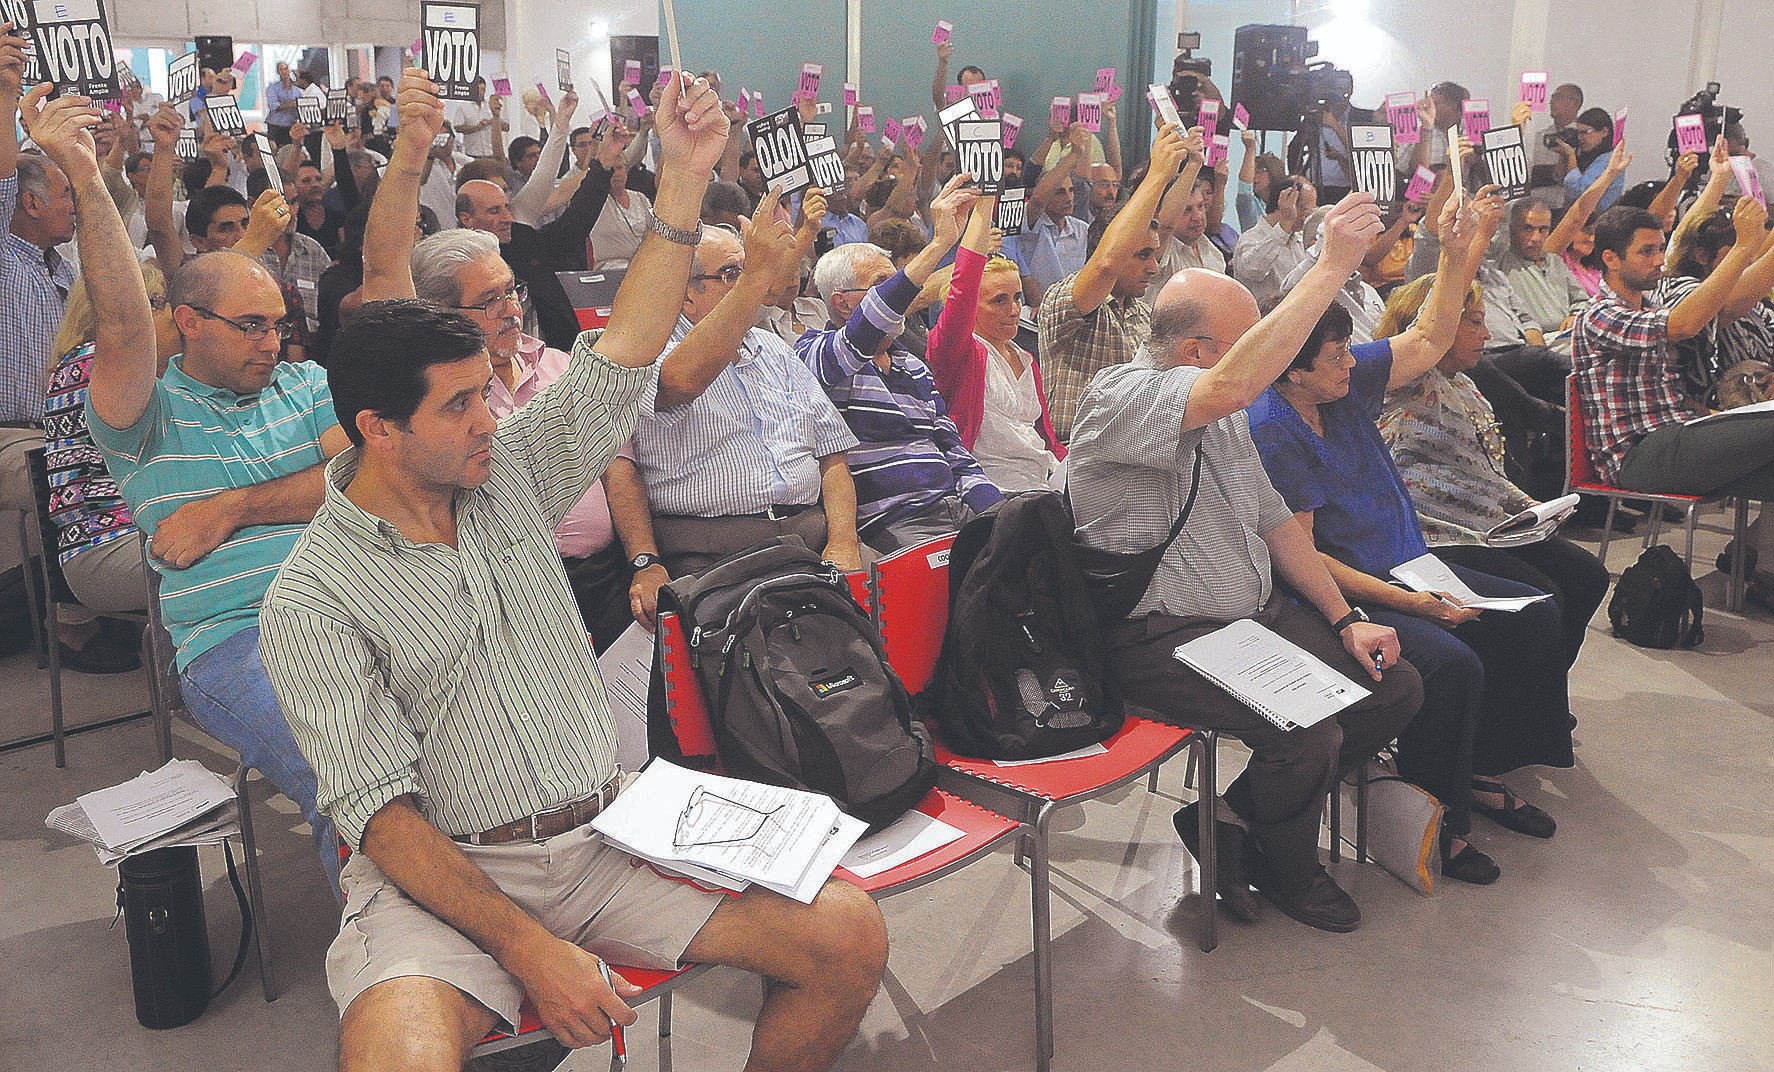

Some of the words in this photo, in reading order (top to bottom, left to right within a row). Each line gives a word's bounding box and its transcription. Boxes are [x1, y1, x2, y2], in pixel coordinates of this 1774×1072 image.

[55, 5, 68, 18] E
[36, 22, 112, 83] VOTO
[424, 30, 478, 84] VOTO
[169, 64, 196, 100] VOTO
[208, 106, 243, 131] VOTO
[297, 105, 322, 123] VOTO
[1079, 103, 1100, 124] VOTO
[1388, 106, 1416, 135] VOTO
[756, 123, 806, 179] VOTO
[958, 141, 1003, 183] VOTO
[1485, 145, 1527, 188] VOTO
[808, 151, 845, 188] VOTO
[1352, 149, 1395, 202] VOTO
[998, 200, 1024, 229] VOTO
[1059, 692, 1074, 702] 32
